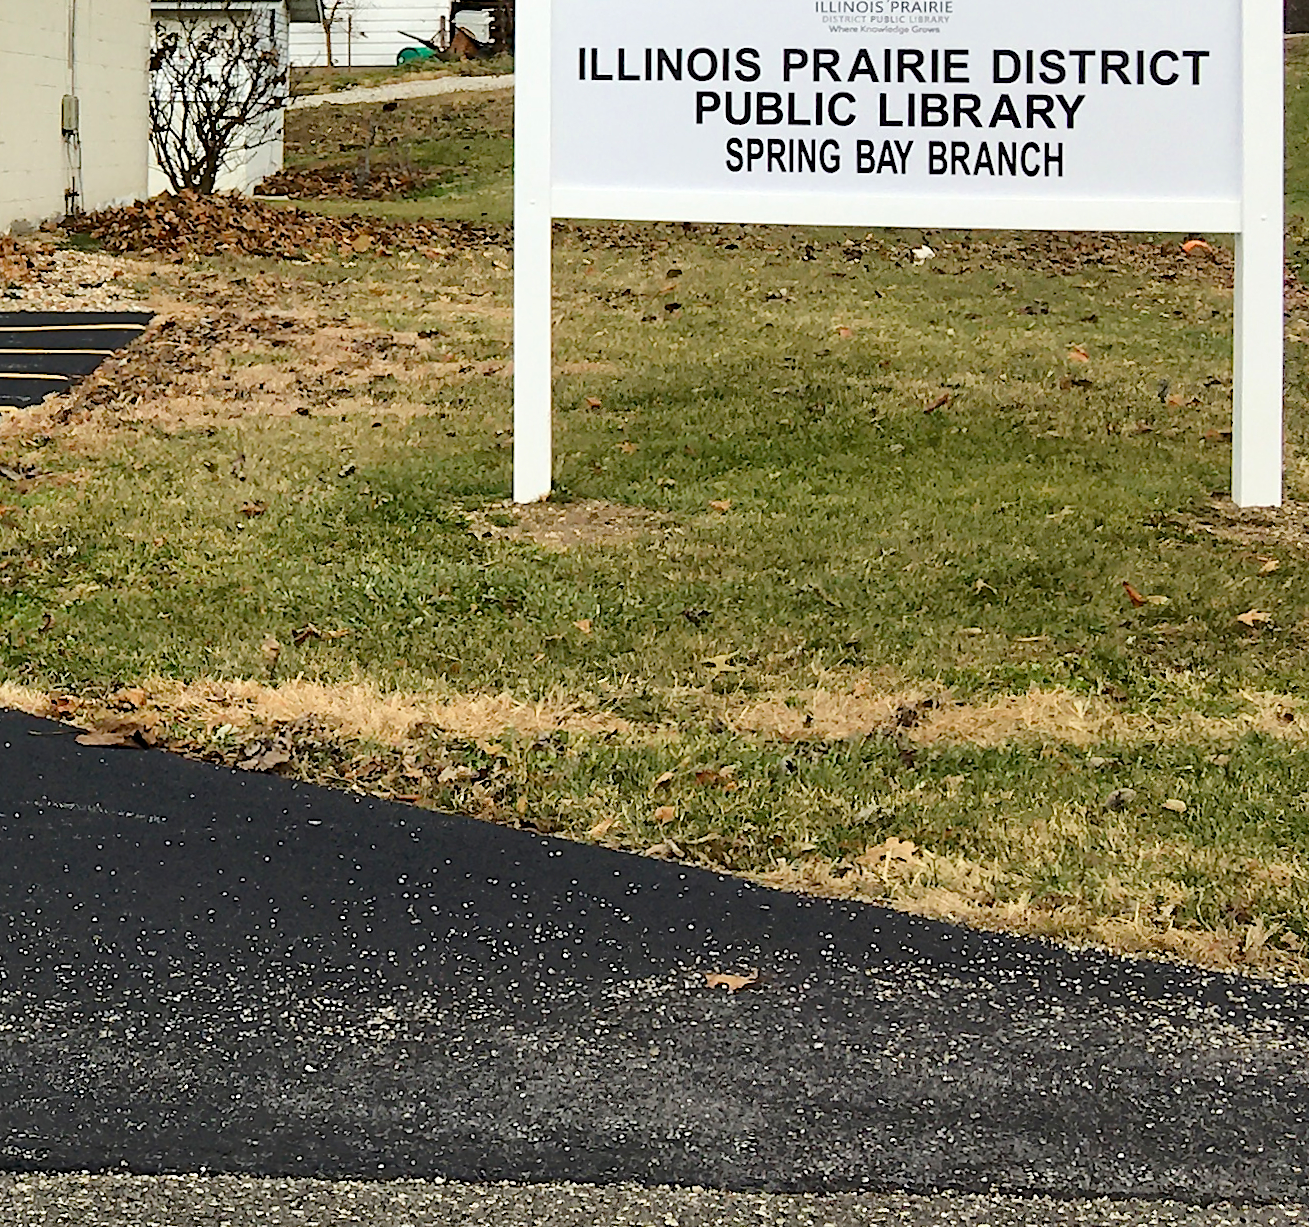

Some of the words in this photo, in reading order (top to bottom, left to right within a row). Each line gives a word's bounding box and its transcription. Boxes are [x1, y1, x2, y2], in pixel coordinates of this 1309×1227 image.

[815, 1, 884, 13] ILLINOIS
[890, 1, 953, 13] PRAIRIE
[822, 15, 867, 23] DISTRICT
[870, 15, 906, 23] PUBLIC
[909, 15, 950, 23] LIBRARY
[829, 25, 859, 33] Where
[860, 25, 910, 35] Knowledge
[911, 25, 941, 34] Grows
[580, 47, 761, 82] ILLINOIS
[784, 49, 970, 84] PRAIRIE
[993, 50, 1210, 86] DISTRICT
[696, 92, 856, 126] PUBLIC
[880, 93, 1085, 129] LIBRARY
[726, 138, 840, 174] SPRING
[857, 140, 913, 175] BAY
[929, 141, 1063, 177] BRANCH
